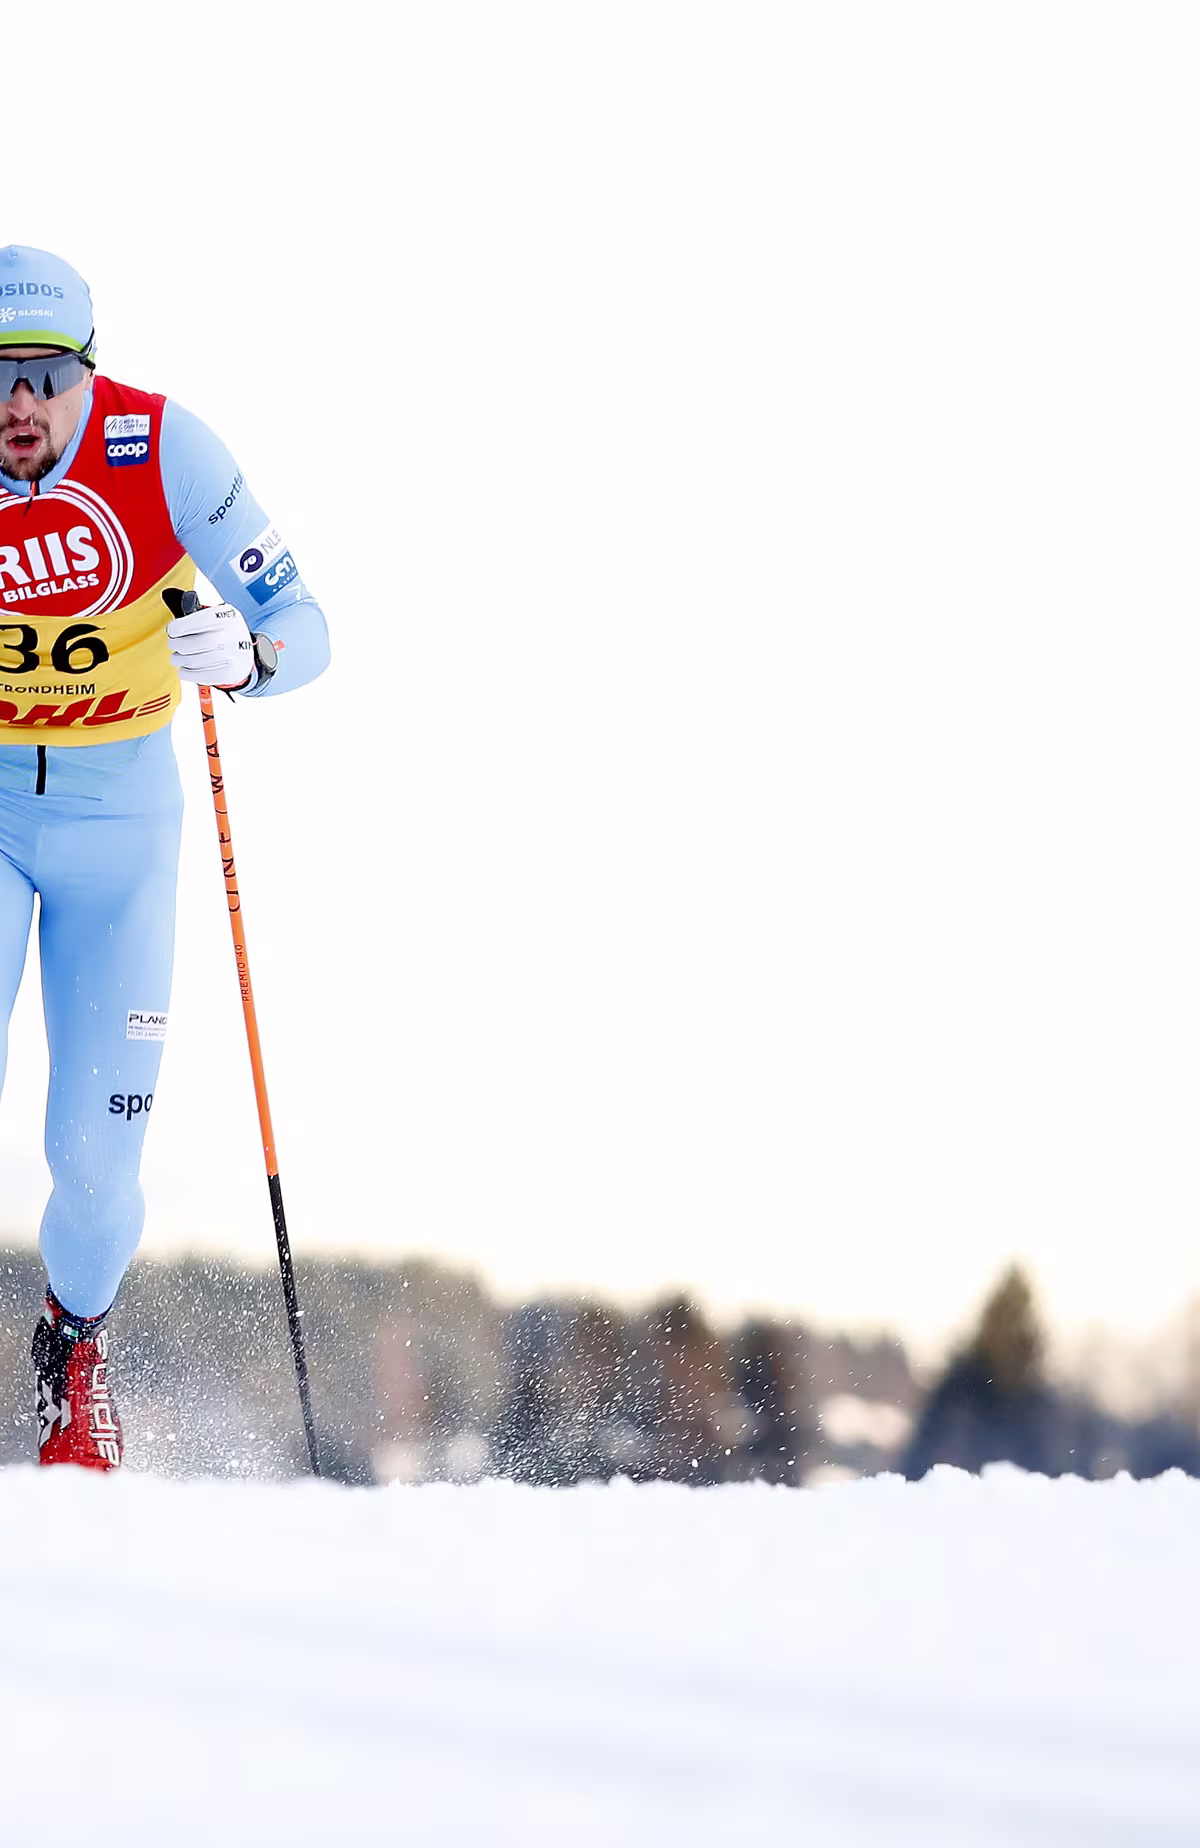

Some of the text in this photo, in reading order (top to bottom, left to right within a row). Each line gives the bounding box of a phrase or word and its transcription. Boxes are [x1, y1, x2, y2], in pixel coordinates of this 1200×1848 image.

[107, 441, 148, 458] coop
[2, 573, 99, 604] BILGLASS
[235, 944, 249, 1002] PREMIO 40
